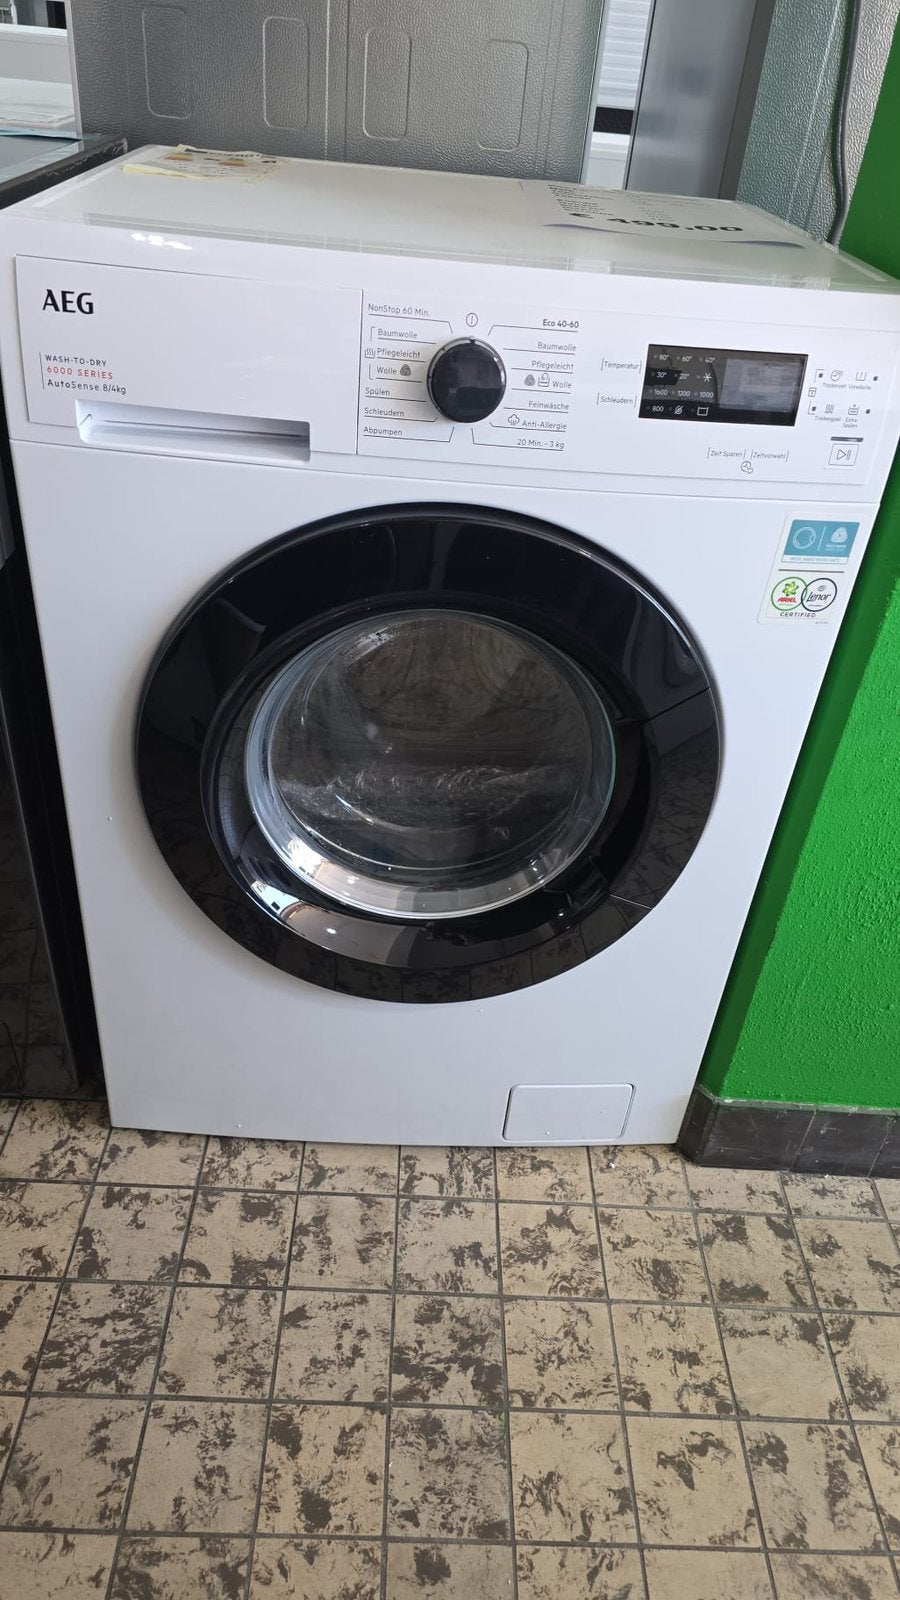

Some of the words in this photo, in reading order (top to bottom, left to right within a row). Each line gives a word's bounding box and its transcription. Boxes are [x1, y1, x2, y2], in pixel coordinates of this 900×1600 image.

[42, 288, 94, 315] AEG
[368, 303, 401, 315] NonStop
[402, 306, 413, 315] 60
[414, 307, 432, 317] Min.
[542, 318, 556, 328] Eco
[557, 319, 580, 329] 40-60
[377, 328, 418, 339] Baumwolle
[537, 341, 577, 352] Baumwolle
[377, 348, 421, 360] Pflegeleicht
[44, 354, 107, 367] WASH-TO-DRY
[531, 360, 574, 371] Pflegeleicht
[604, 360, 640, 370] Temperatur
[46, 366, 73, 376] 6000
[77, 368, 114, 380] SERIES
[376, 365, 398, 376] Wolle
[47, 379, 100, 392] AutoSense
[102, 384, 127, 396] 8/4kg
[552, 379, 572, 390] Wolle
[364, 386, 391, 397] Spülen
[528, 400, 570, 410] Feinwäsche
[600, 396, 634, 404] Schleudern
[364, 407, 405, 418] Schleudern
[522, 420, 568, 431] Anti-Allergie
[363, 426, 403, 438] Abpumpen
[517, 438, 526, 446] 20
[528, 439, 543, 448] Min.
[549, 440, 554, 448] 3
[555, 441, 565, 450] kg
[723, 450, 743, 458] Sparen
[752, 452, 786, 460] Zeitvorwahl
[806, 591, 832, 603] Lenor
